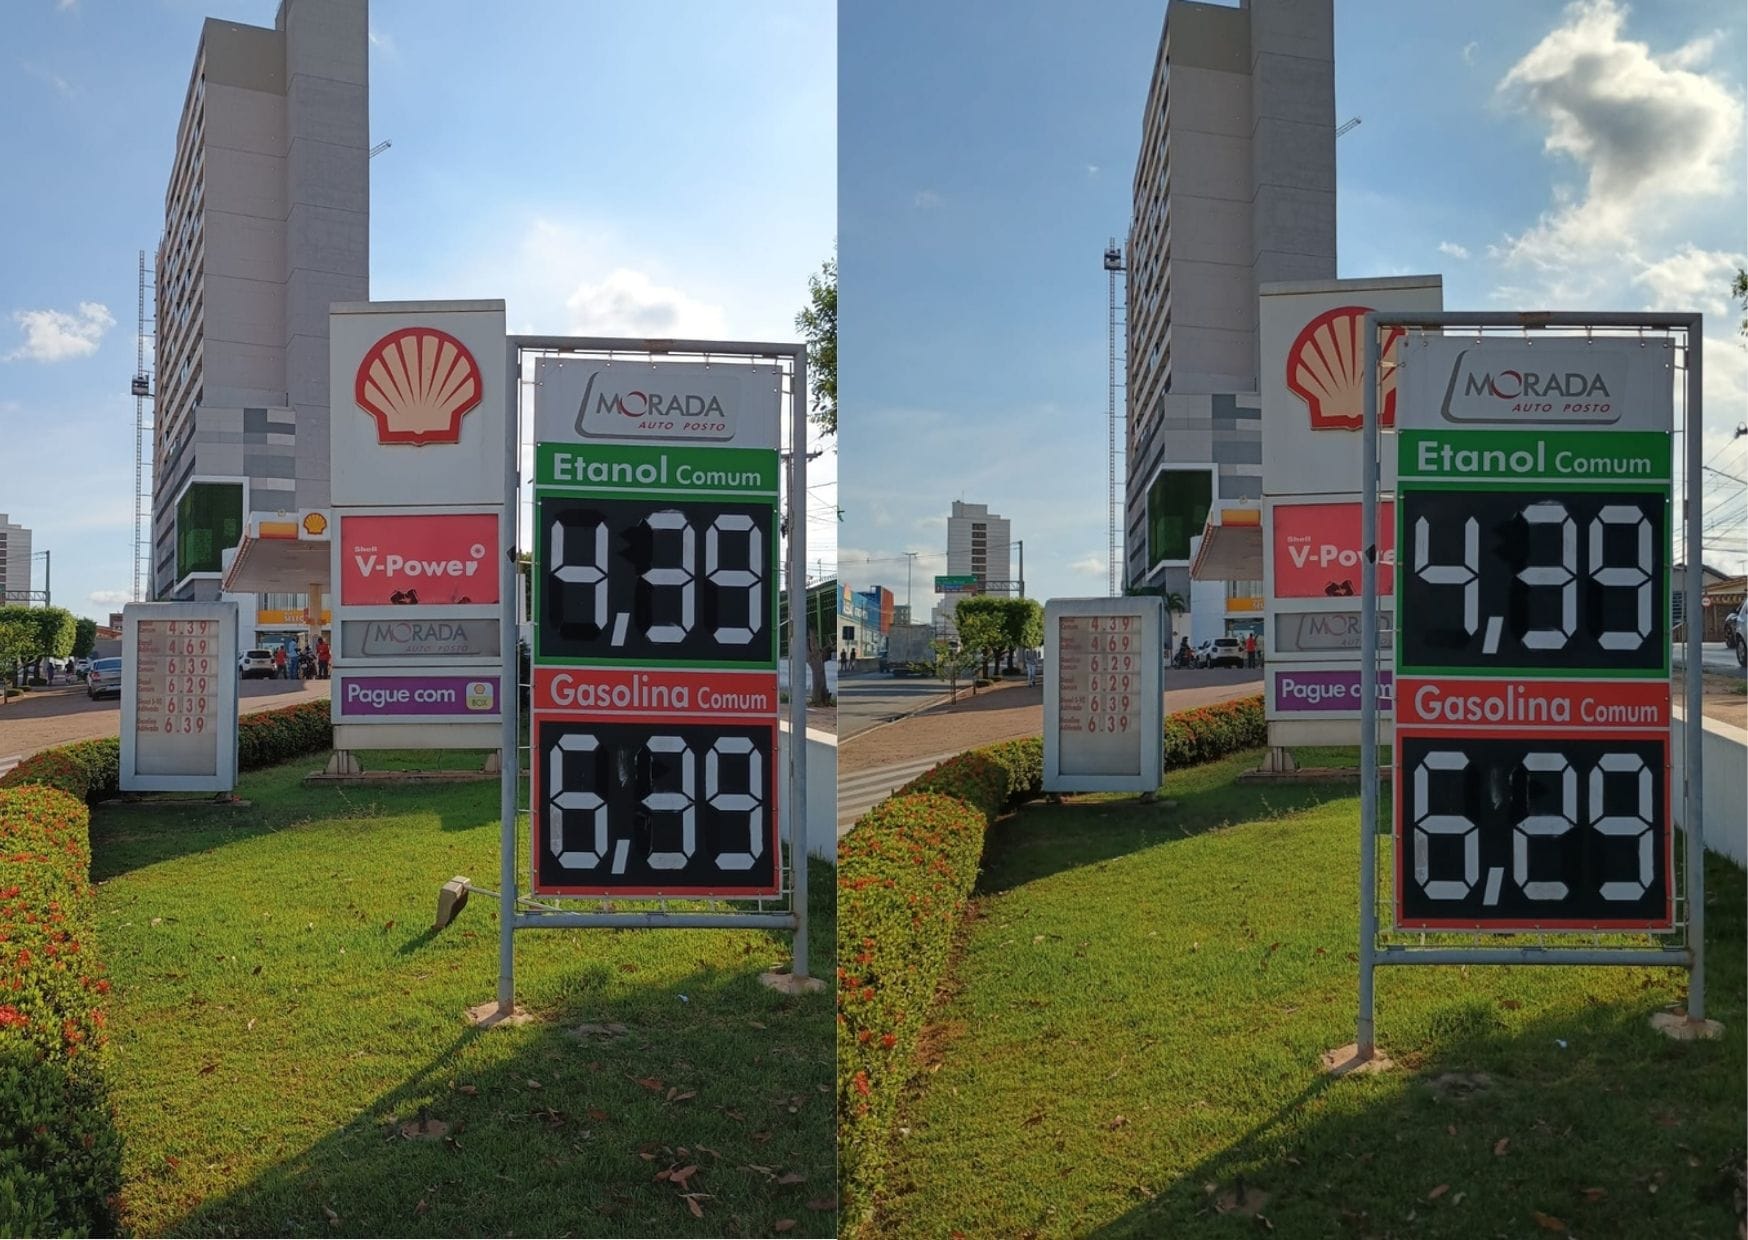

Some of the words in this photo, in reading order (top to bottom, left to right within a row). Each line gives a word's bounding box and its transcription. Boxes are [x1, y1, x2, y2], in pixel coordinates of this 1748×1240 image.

[1465, 370, 1610, 400] MORADA
[596, 391, 725, 418] MORADA
[1512, 403, 1552, 413] AUTO
[1563, 403, 1610, 413] POSTO
[638, 421, 673, 431] AUTO
[683, 422, 725, 432] POSTO
[554, 453, 667, 484] Etanol
[676, 465, 761, 486] Comum
[1417, 441, 1545, 473] Etanol
[1555, 452, 1651, 473] Comum
[355, 555, 478, 577] V-Power
[551, 511, 762, 647] 4,39
[1415, 504, 1652, 654] 4,39
[374, 623, 469, 643] MORADA
[348, 684, 410, 708] Pague
[414, 688, 456, 703] com
[550, 673, 689, 708] Gasolina
[697, 687, 767, 710] Comum
[1282, 679, 1346, 703] Pague
[1414, 685, 1571, 722] Gasolina
[1581, 698, 1658, 723] Comum
[550, 734, 763, 874] 6,39
[1414, 751, 1654, 906] 6,29
